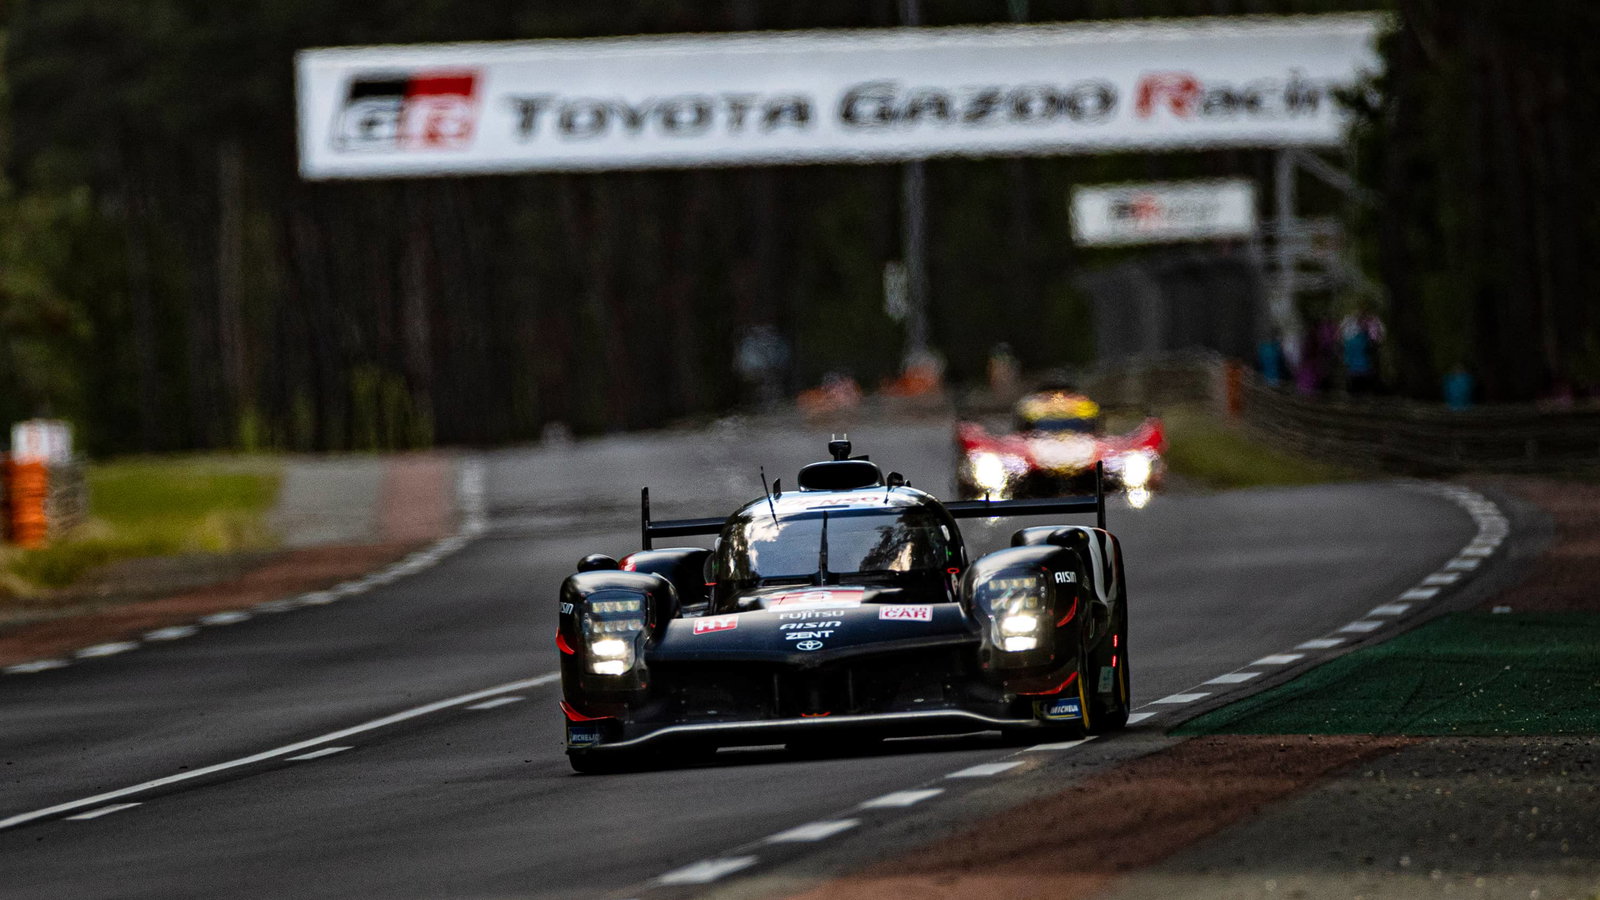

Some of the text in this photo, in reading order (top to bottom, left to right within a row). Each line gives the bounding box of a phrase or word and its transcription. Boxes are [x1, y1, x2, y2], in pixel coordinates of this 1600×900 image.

[509, 94, 810, 139] TOYOTA
[1054, 571, 1077, 583] AISIN
[780, 609, 845, 619] FUJITSU
[884, 610, 927, 619] CAR
[696, 616, 736, 631] HY
[780, 620, 842, 630] AISIN
[785, 630, 834, 640] ZENT
